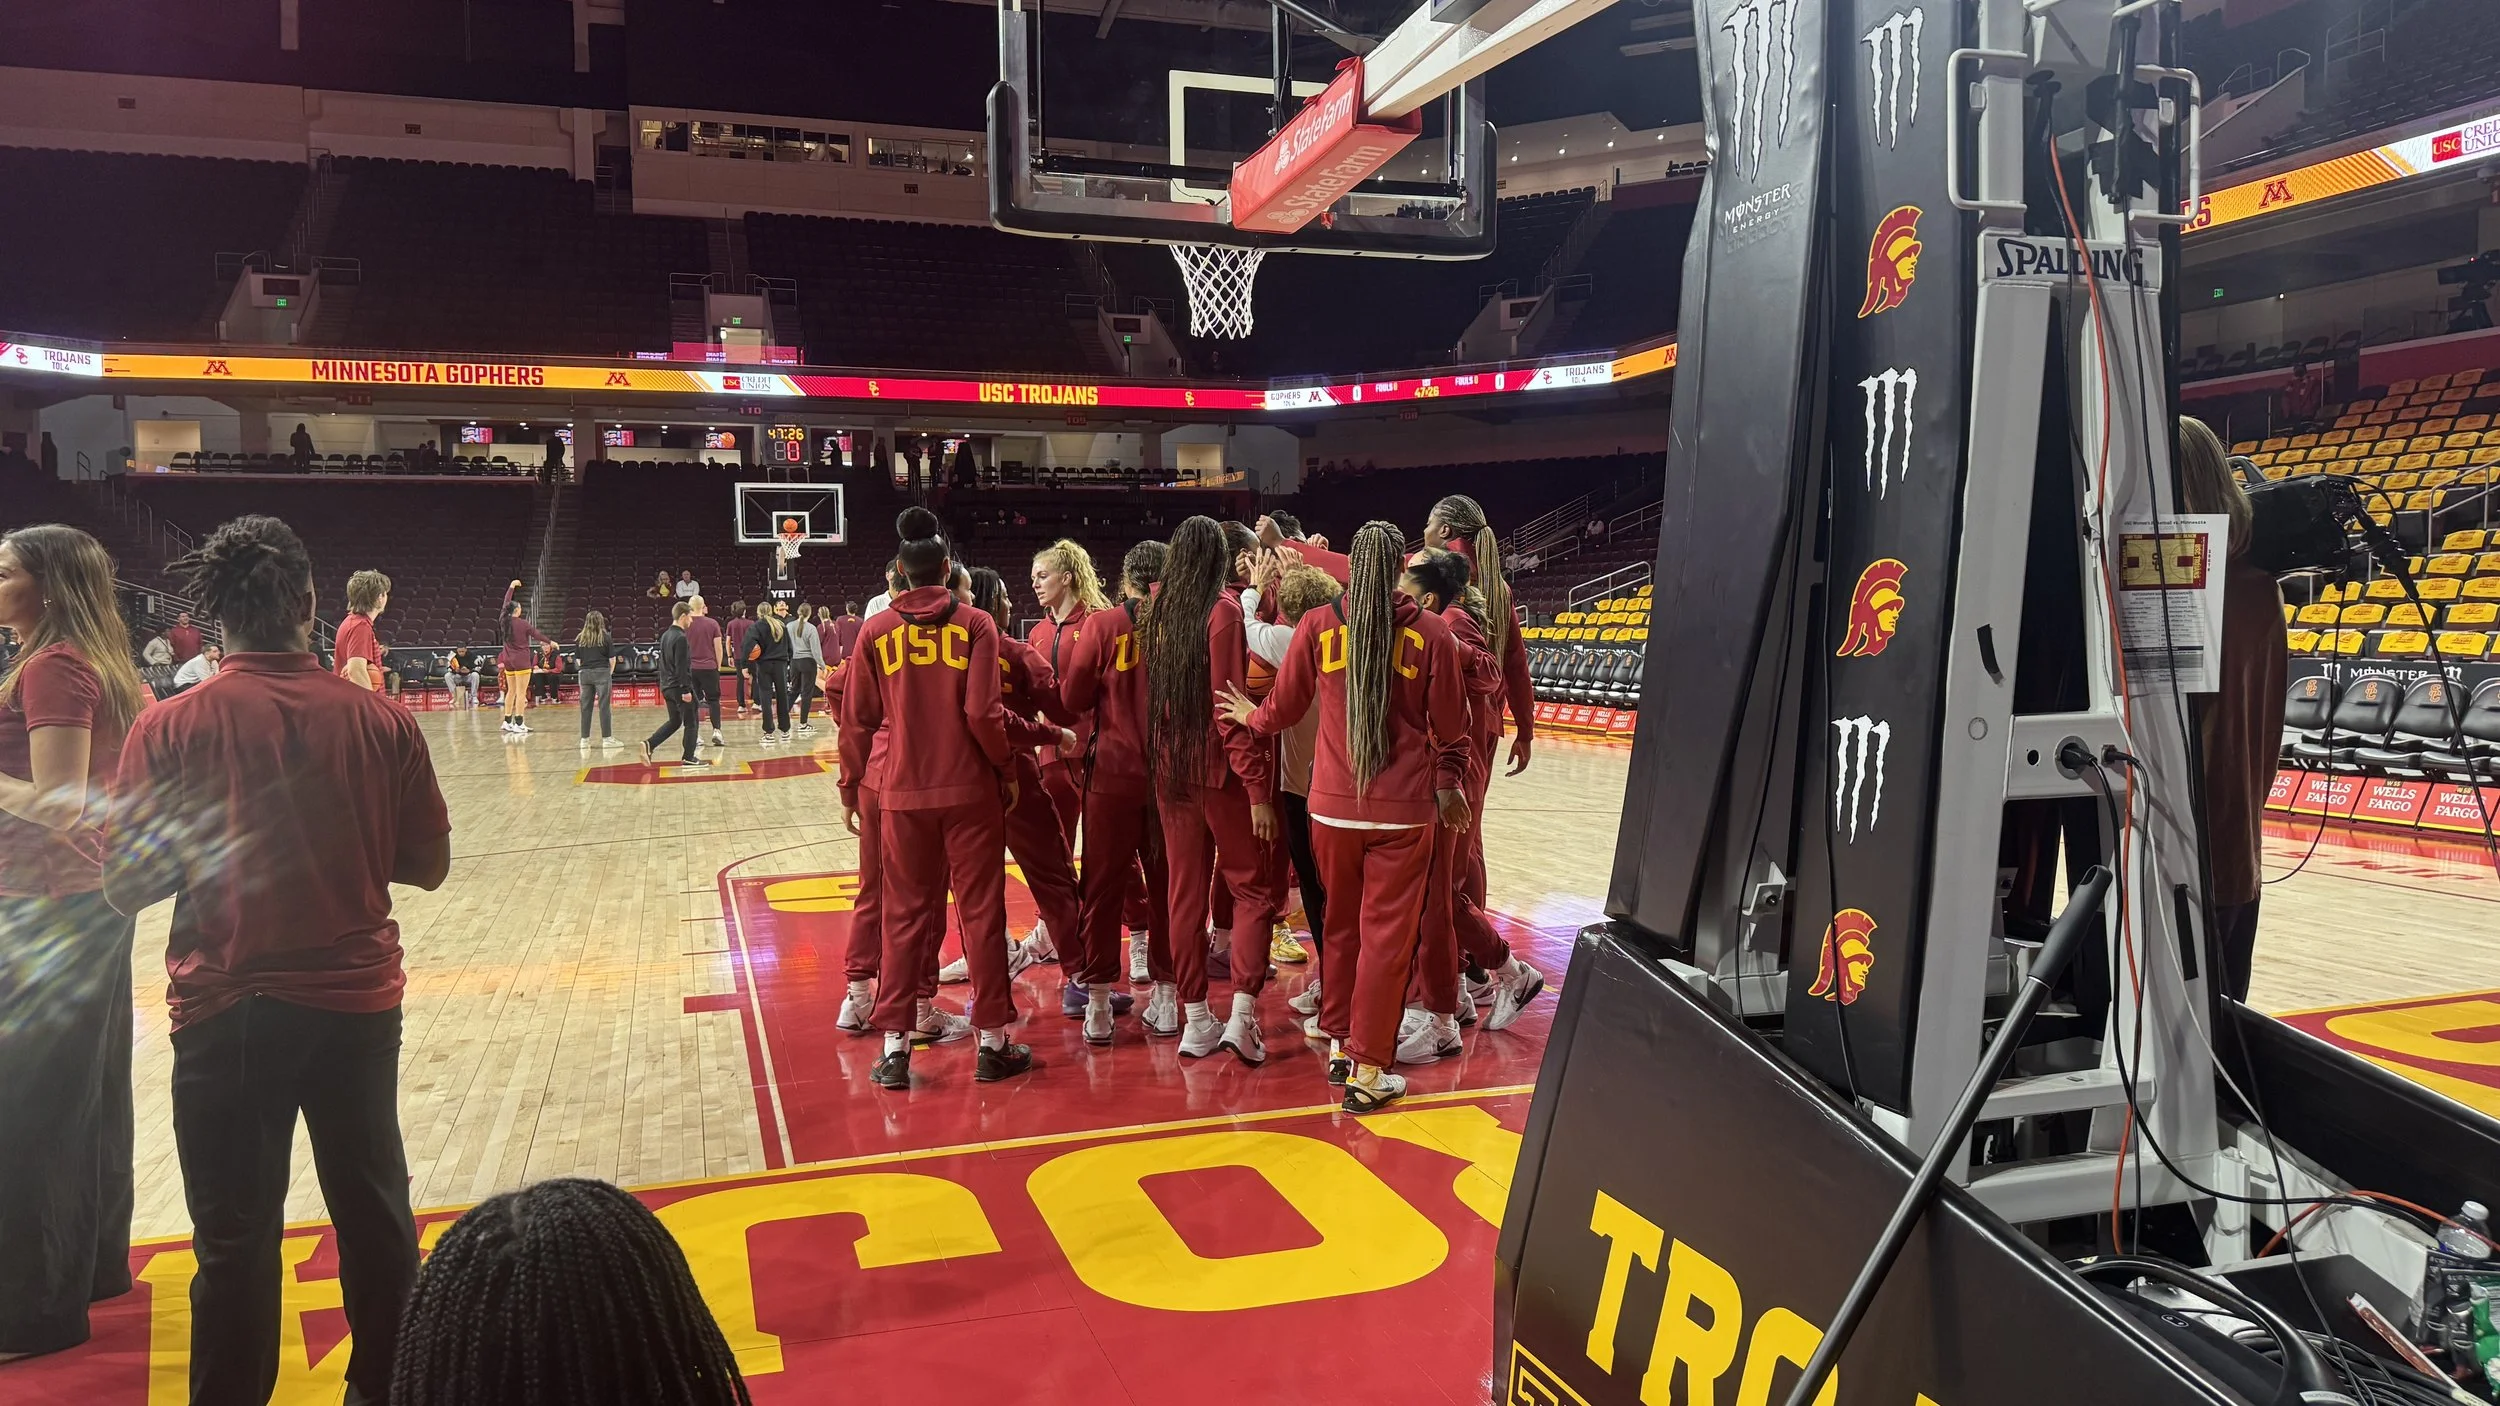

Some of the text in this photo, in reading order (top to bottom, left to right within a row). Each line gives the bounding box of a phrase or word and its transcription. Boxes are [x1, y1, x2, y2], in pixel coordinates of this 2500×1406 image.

[2433, 137, 2461, 155] USC
[1724, 183, 1791, 224] MONSTER
[1733, 208, 1779, 233] ENERGY
[43, 350, 91, 365] TROJANS
[52, 362, 64, 371] TOL
[1565, 365, 1605, 377] TROJANS
[312, 361, 544, 386] MINNESOTA GOPHERS
[742, 376, 771, 384] CREDIT
[723, 379, 740, 387] USC
[1455, 376, 1473, 386] FOULS
[1495, 373, 1505, 390] 0
[979, 383, 1098, 406] USC TROJANS
[1375, 383, 1393, 393] FOULS
[1414, 386, 1439, 398] 47:26
[1270, 391, 1301, 401] GOPHERS
[740, 407, 761, 415] 110
[767, 428, 804, 440] 47:26
[771, 590, 796, 598] YETI
[875, 623, 969, 676] USC
[1320, 624, 1425, 680] UC
[2311, 780, 2352, 793] WELLS
[2373, 786, 2417, 799] WELLS
[2367, 798, 2411, 812] FARGO
[2440, 792, 2487, 806] WELLS
[2434, 805, 2481, 819] FARGO
[1586, 1189, 1951, 1406] TRO
